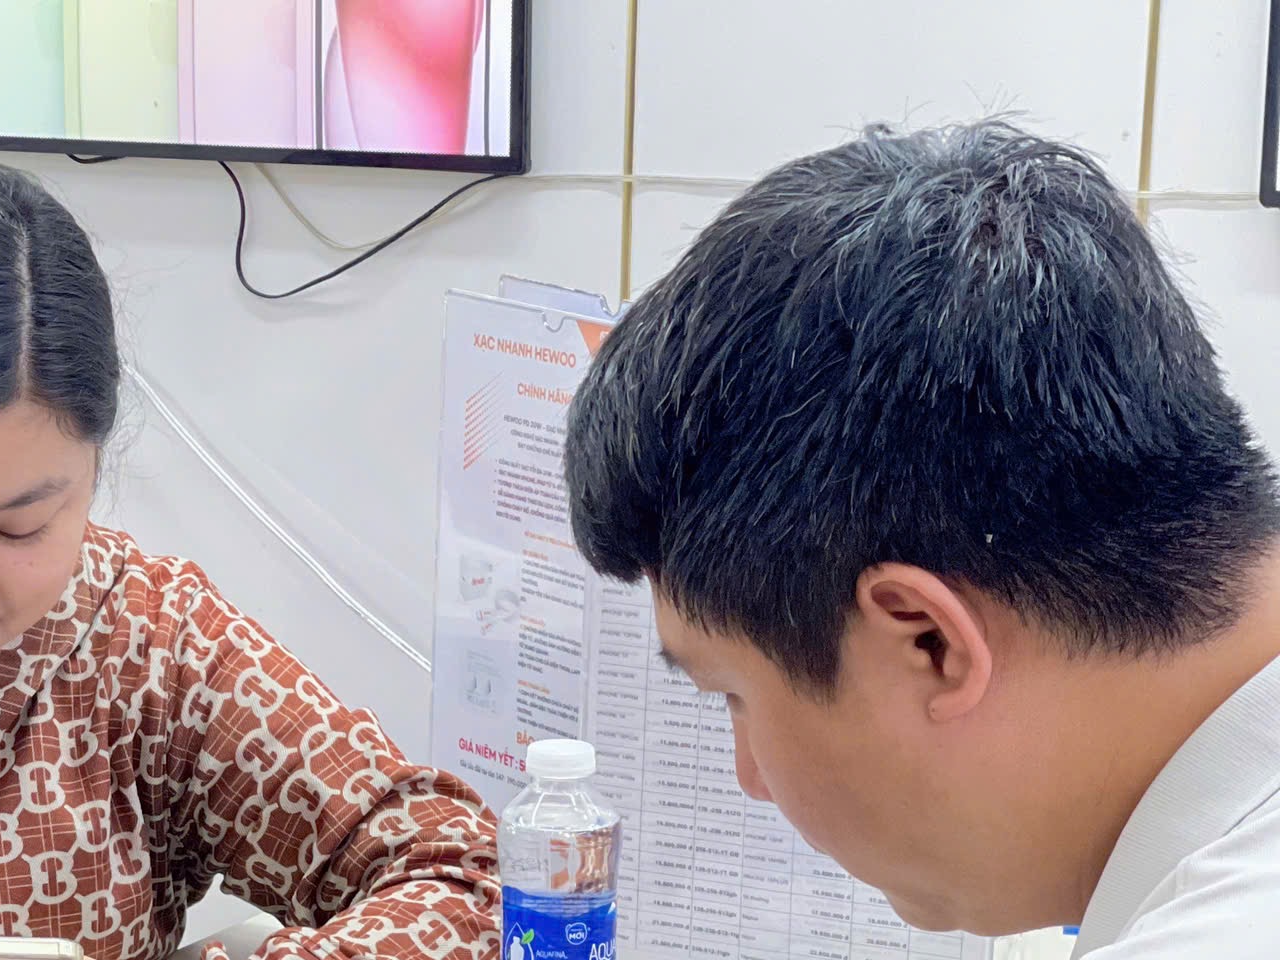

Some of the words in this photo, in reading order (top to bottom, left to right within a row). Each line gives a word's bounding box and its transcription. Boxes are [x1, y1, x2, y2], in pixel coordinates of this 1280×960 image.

[497, 338, 533, 359] NHANH
[535, 347, 576, 368] HEWOO
[475, 743, 496, 762] NIÊM
